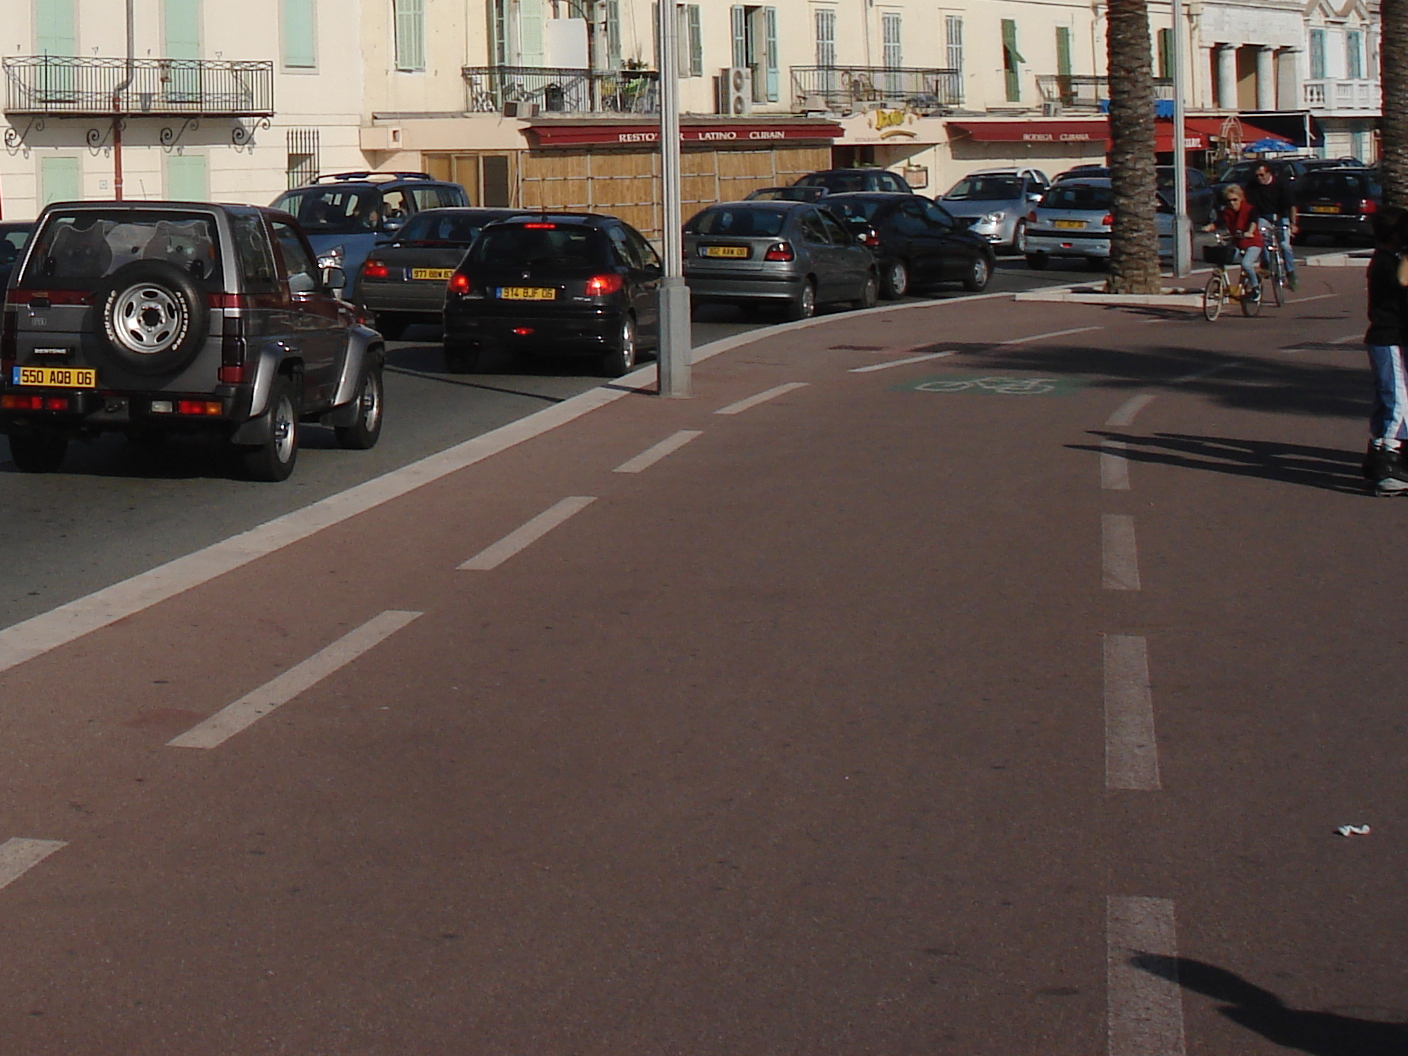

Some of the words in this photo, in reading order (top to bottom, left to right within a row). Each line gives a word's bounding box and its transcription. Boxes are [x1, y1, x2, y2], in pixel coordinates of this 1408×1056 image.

[698, 131, 737, 141] LATINO
[749, 130, 785, 140] CUBAIN
[503, 287, 519, 297] 914
[21, 369, 44, 384] 550
[49, 370, 72, 385] AQB
[76, 371, 92, 385] 06
